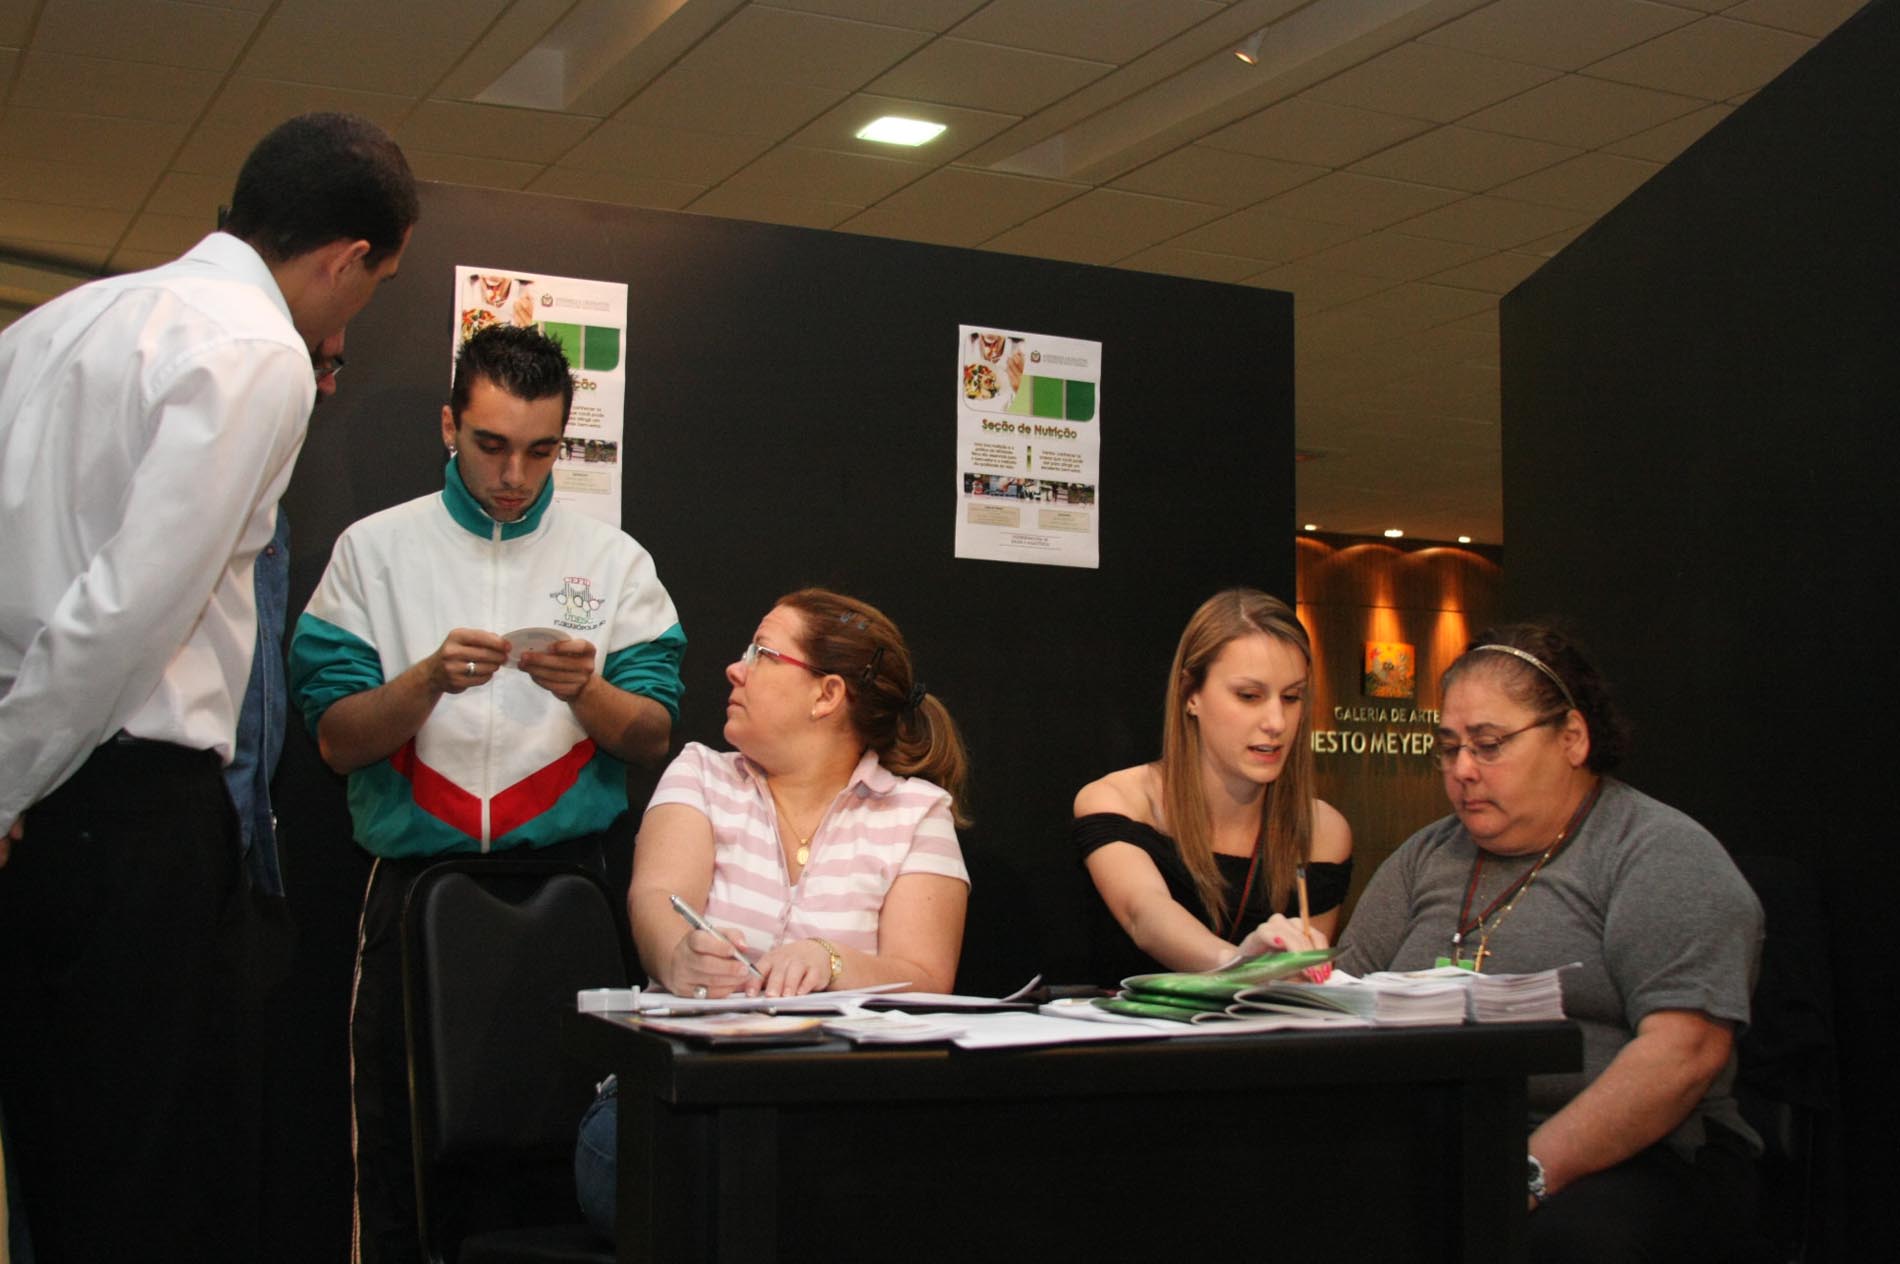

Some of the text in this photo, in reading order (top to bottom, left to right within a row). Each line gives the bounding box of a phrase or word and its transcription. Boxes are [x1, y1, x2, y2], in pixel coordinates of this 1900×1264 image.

[982, 418, 1078, 440] Seção de Nutrição
[1334, 706, 1440, 724] GALERIA DE ARTE
[1370, 731, 1434, 755] MEYER
